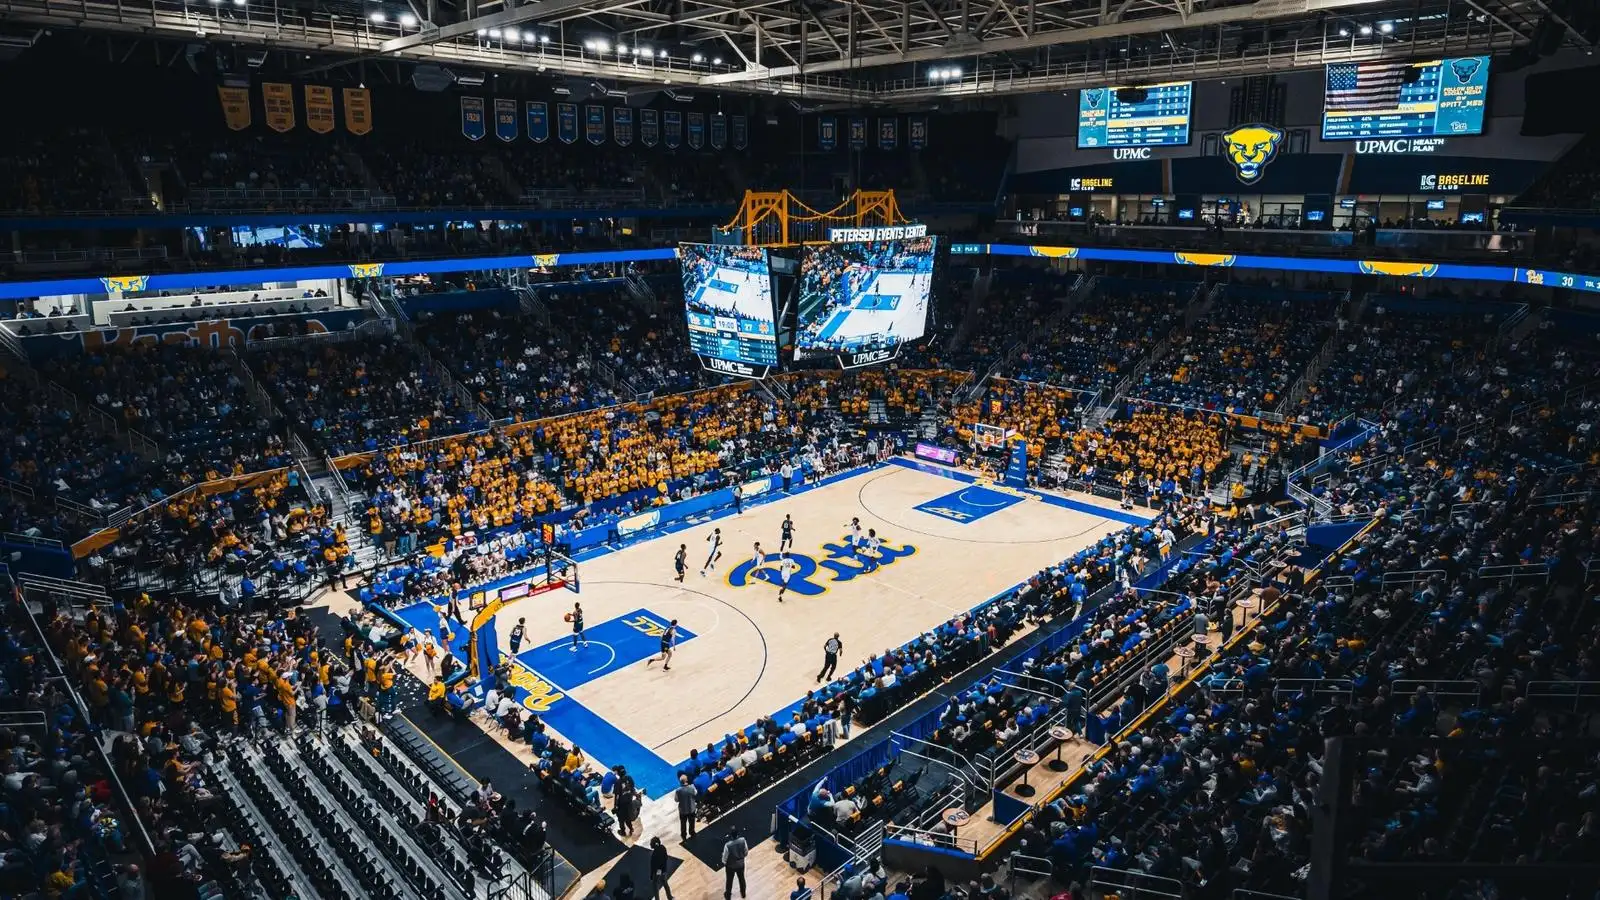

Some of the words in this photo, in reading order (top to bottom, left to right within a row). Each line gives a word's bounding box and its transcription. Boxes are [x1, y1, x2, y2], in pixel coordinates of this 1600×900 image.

[1356, 140, 1408, 154] UPMC
[1114, 148, 1151, 160] UPMC
[1421, 175, 1436, 185] IC
[1438, 174, 1489, 184] BASELINE
[832, 229, 875, 242] PETERSEN
[876, 227, 904, 240] EVENTS
[904, 225, 927, 238] CENTER
[1562, 276, 1574, 286] 30
[718, 320, 735, 329] 19:00
[853, 351, 878, 364] UPMC
[710, 358, 738, 372] UPMC
[723, 533, 919, 597] Pitt
